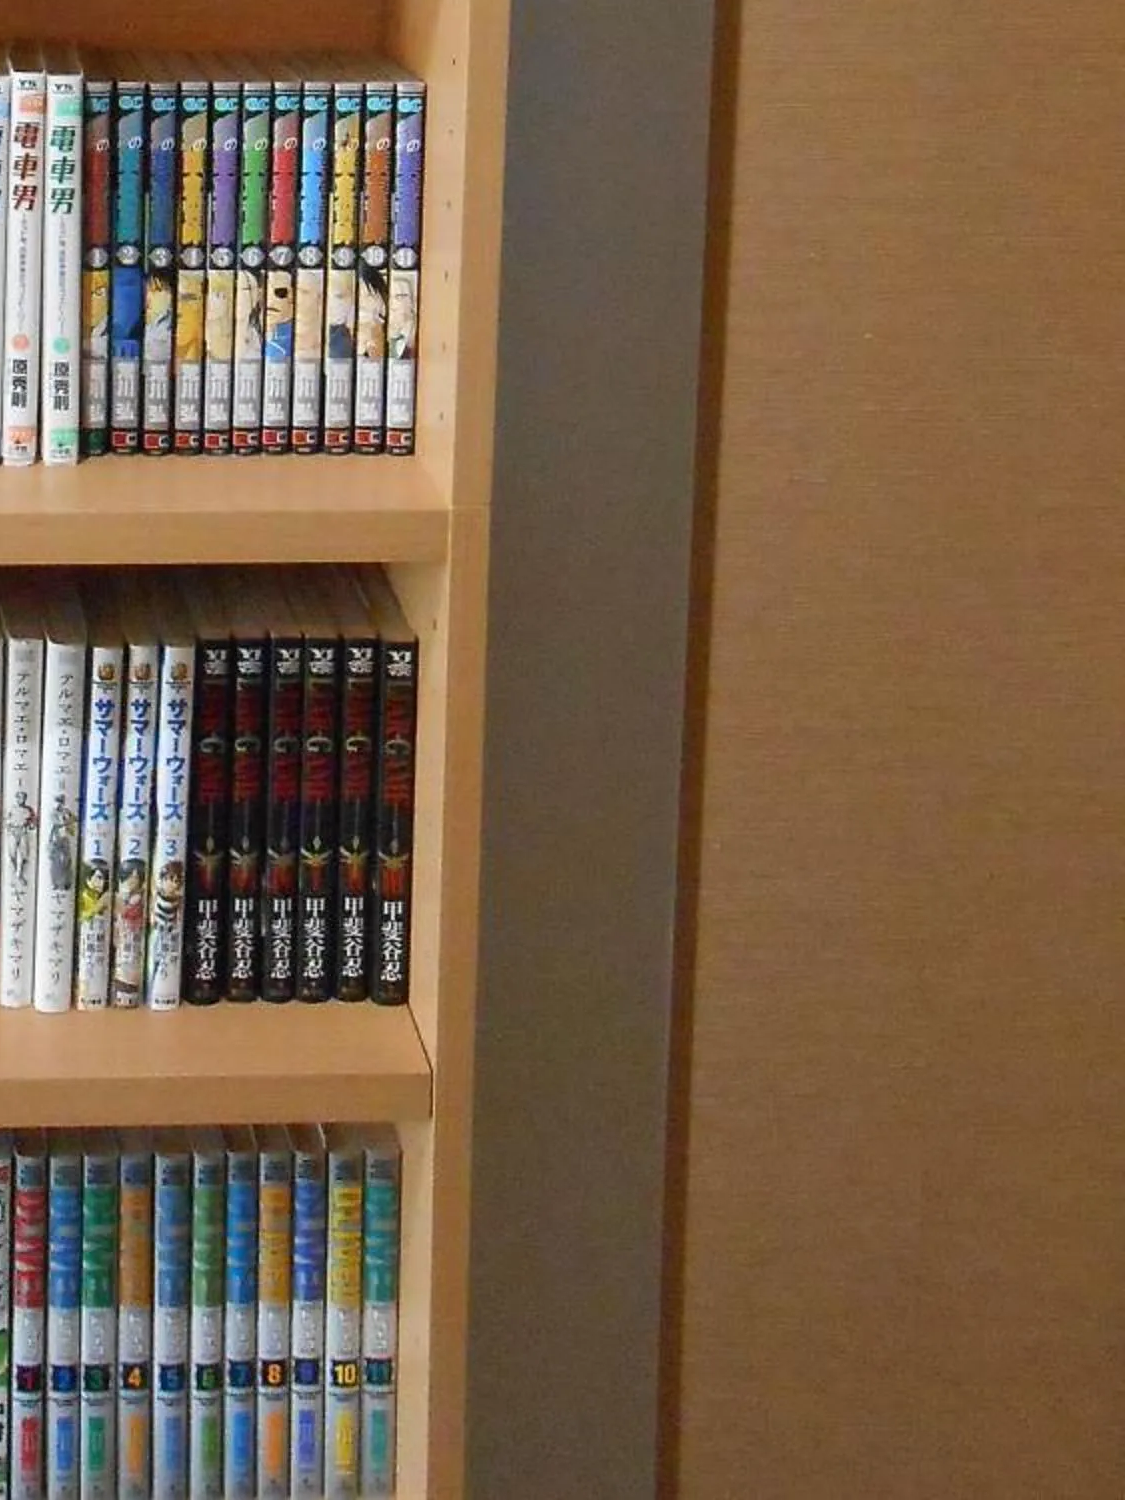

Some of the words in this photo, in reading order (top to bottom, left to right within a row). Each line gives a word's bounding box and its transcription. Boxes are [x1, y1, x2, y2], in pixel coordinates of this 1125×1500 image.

[13, 122, 40, 211] 電車男
[50, 126, 75, 214] 電車男
[90, 700, 115, 821] サマーウォーズ
[127, 700, 152, 821] サマーウォーズ
[163, 698, 189, 821] サマーウォーズ
[130, 840, 140, 856] 2
[166, 841, 176, 857] 3
[128, 1366, 141, 1387] 4
[267, 1365, 280, 1384] 8
[334, 1364, 356, 1384] 10
